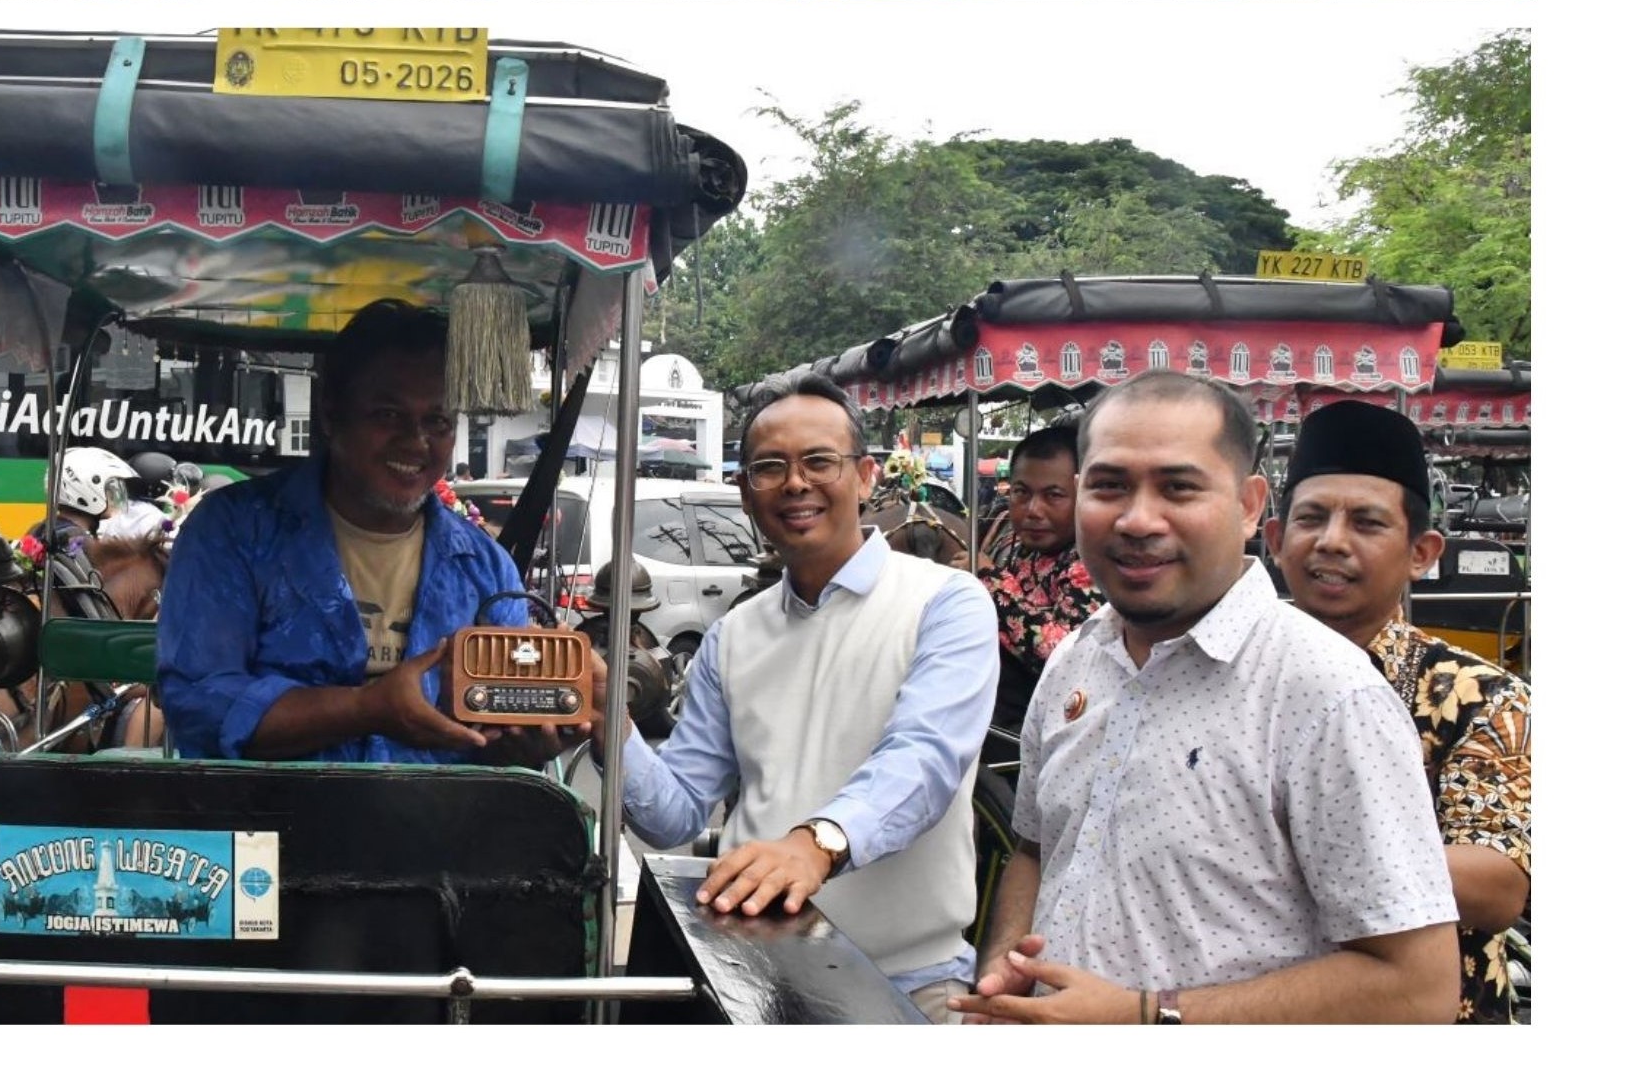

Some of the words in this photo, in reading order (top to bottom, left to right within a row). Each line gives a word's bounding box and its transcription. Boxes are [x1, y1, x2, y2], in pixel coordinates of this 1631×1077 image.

[200, 213, 243, 224] TUPITU
[587, 237, 629, 255] TUPITU
[1261, 257, 1282, 274] YK
[1291, 258, 1323, 276] 227
[1331, 260, 1363, 278] KTB
[116, 837, 230, 900] WISATA
[47, 914, 92, 931] JOGJA
[94, 916, 179, 934] ISTIMEWA
